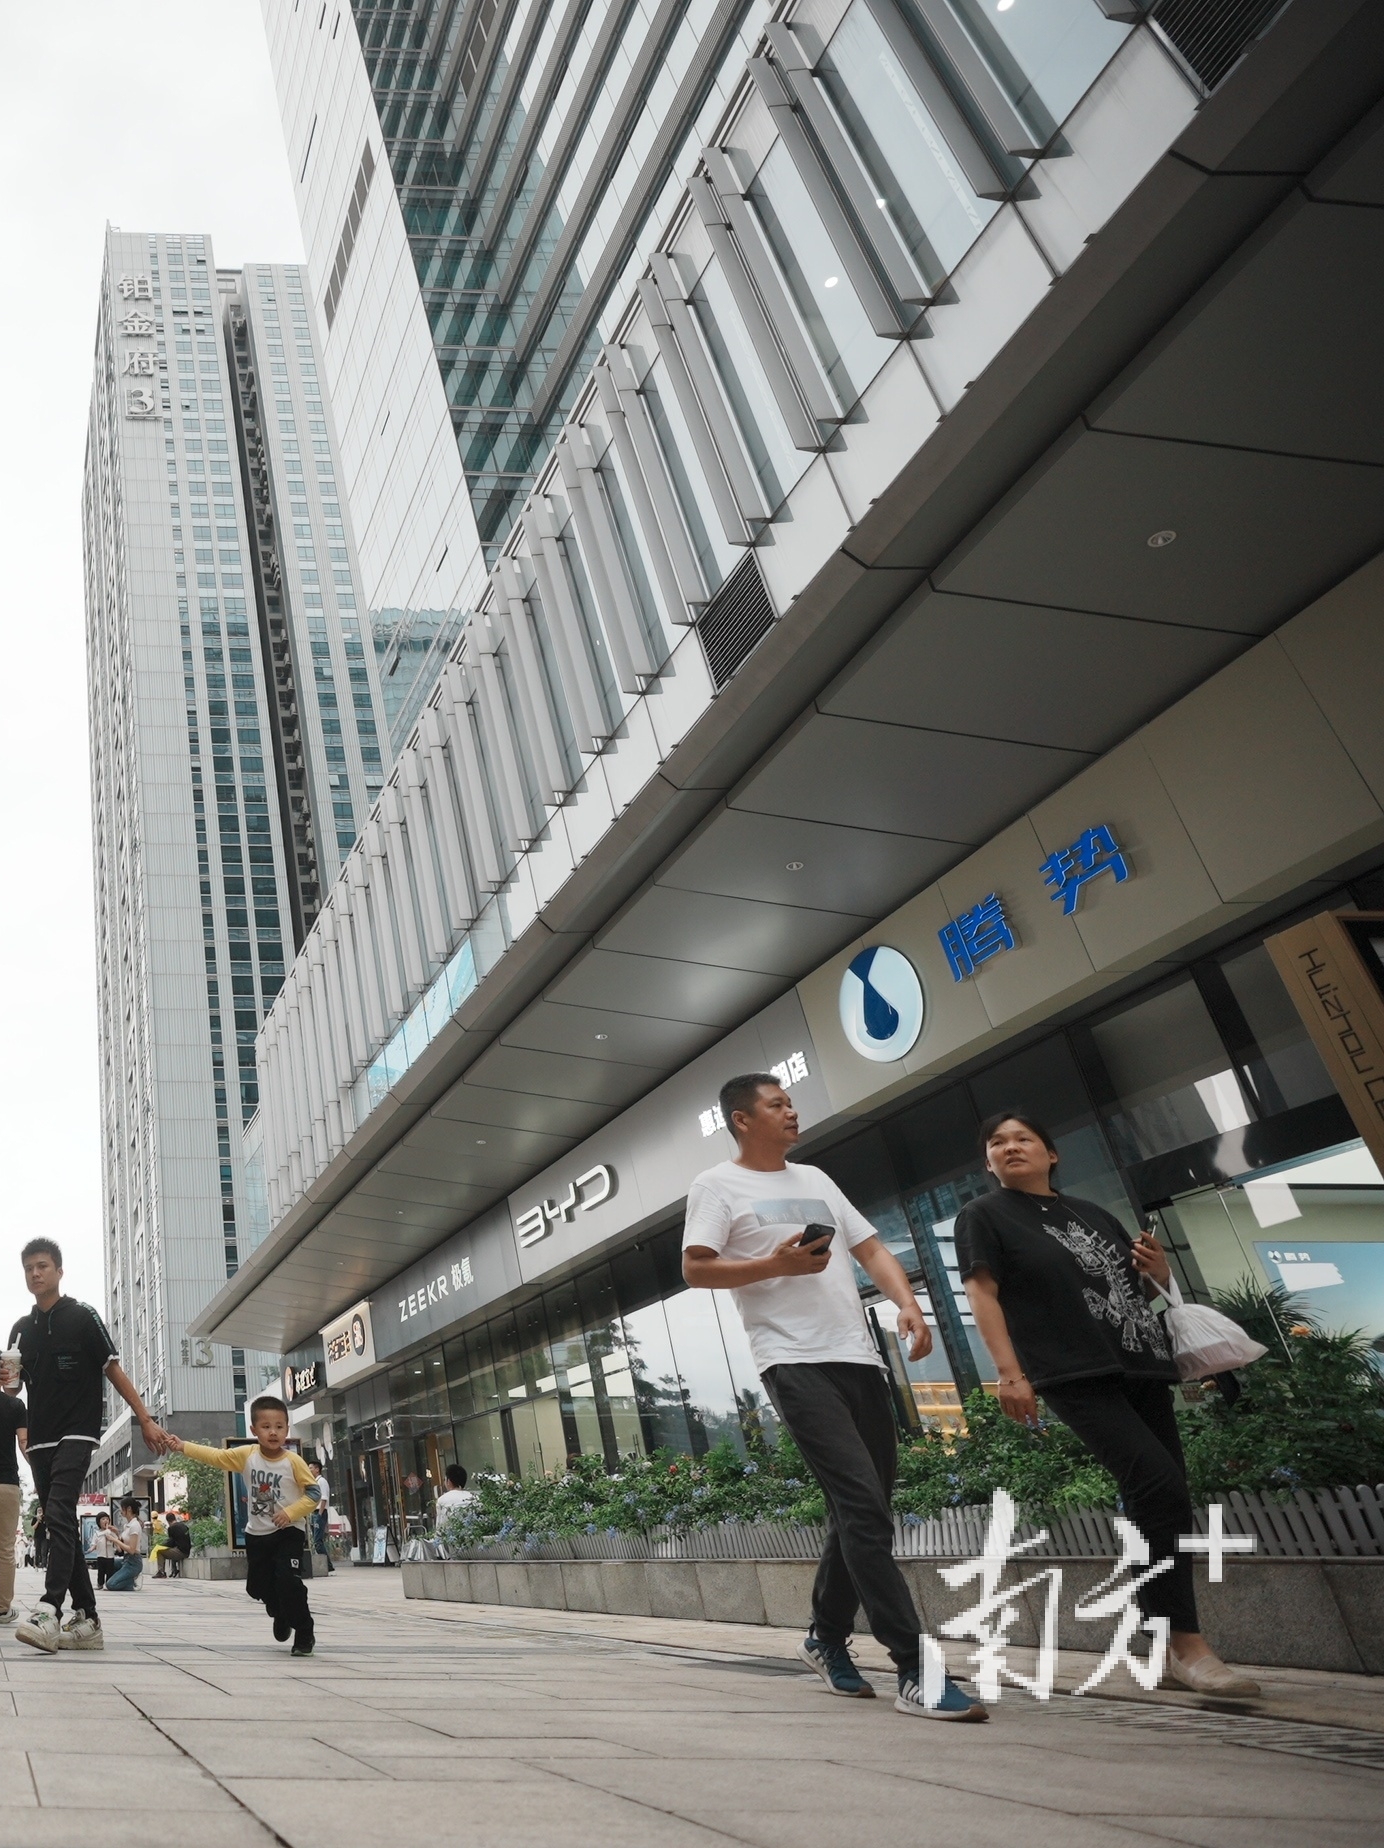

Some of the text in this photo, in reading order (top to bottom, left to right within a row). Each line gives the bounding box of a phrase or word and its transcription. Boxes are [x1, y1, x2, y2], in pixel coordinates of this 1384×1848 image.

[937, 824, 1130, 984] 腾势
[1298, 947, 1374, 1075] Huizhou
[515, 1164, 612, 1249] BYD
[398, 1256, 475, 1323] ZEEKR 极氪
[251, 1469, 283, 1489] ROCK
[251, 1486, 281, 1500] DN
